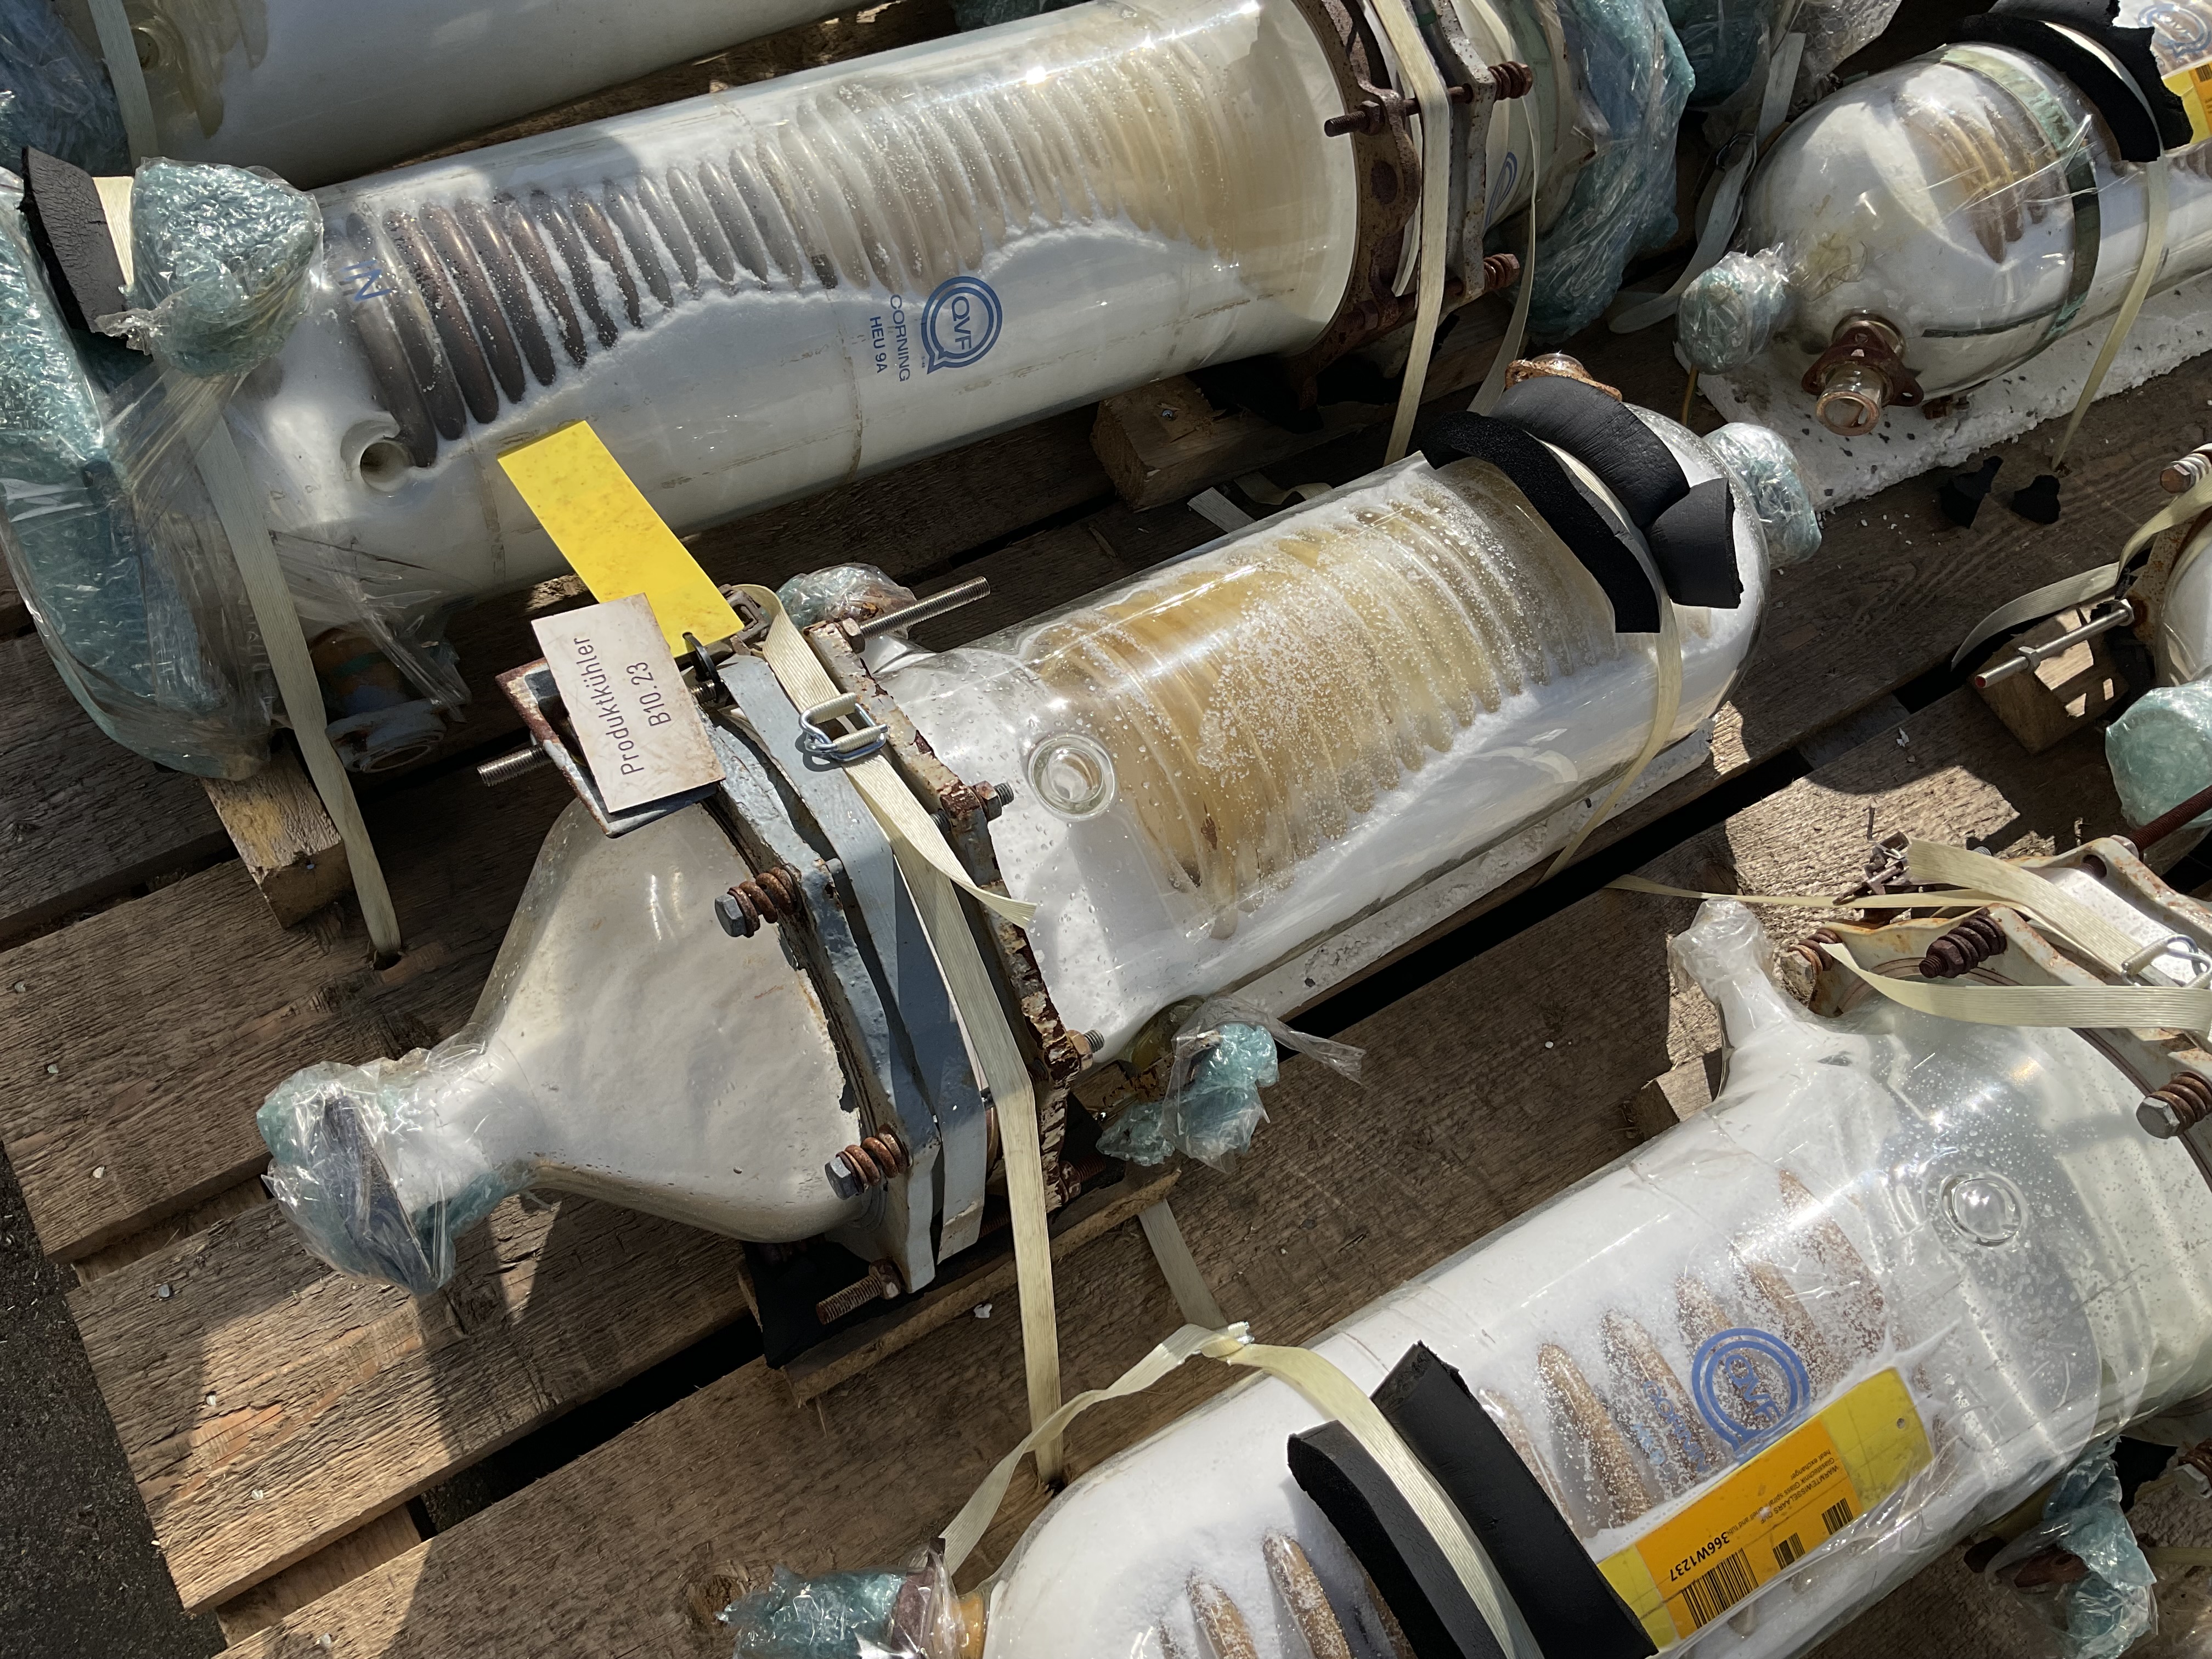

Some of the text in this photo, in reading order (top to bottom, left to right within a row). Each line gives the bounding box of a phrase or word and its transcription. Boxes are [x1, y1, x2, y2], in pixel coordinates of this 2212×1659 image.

[870, 316, 888, 374] HEU 9A
[890, 294, 911, 382] CORNING
[951, 296, 972, 351] QVF
[573, 637, 645, 775] Produktkühler
[626, 662, 672, 726] B10.23
[1725, 1354, 1781, 1422] QVF
[1643, 1380, 1711, 1472] CORNIN
[1784, 1481, 1801, 1495] Glass
[1790, 1458, 1818, 1480] exchanger
[1738, 1516, 1749, 1529] and
[1669, 1531, 1730, 1582] 366W1237
